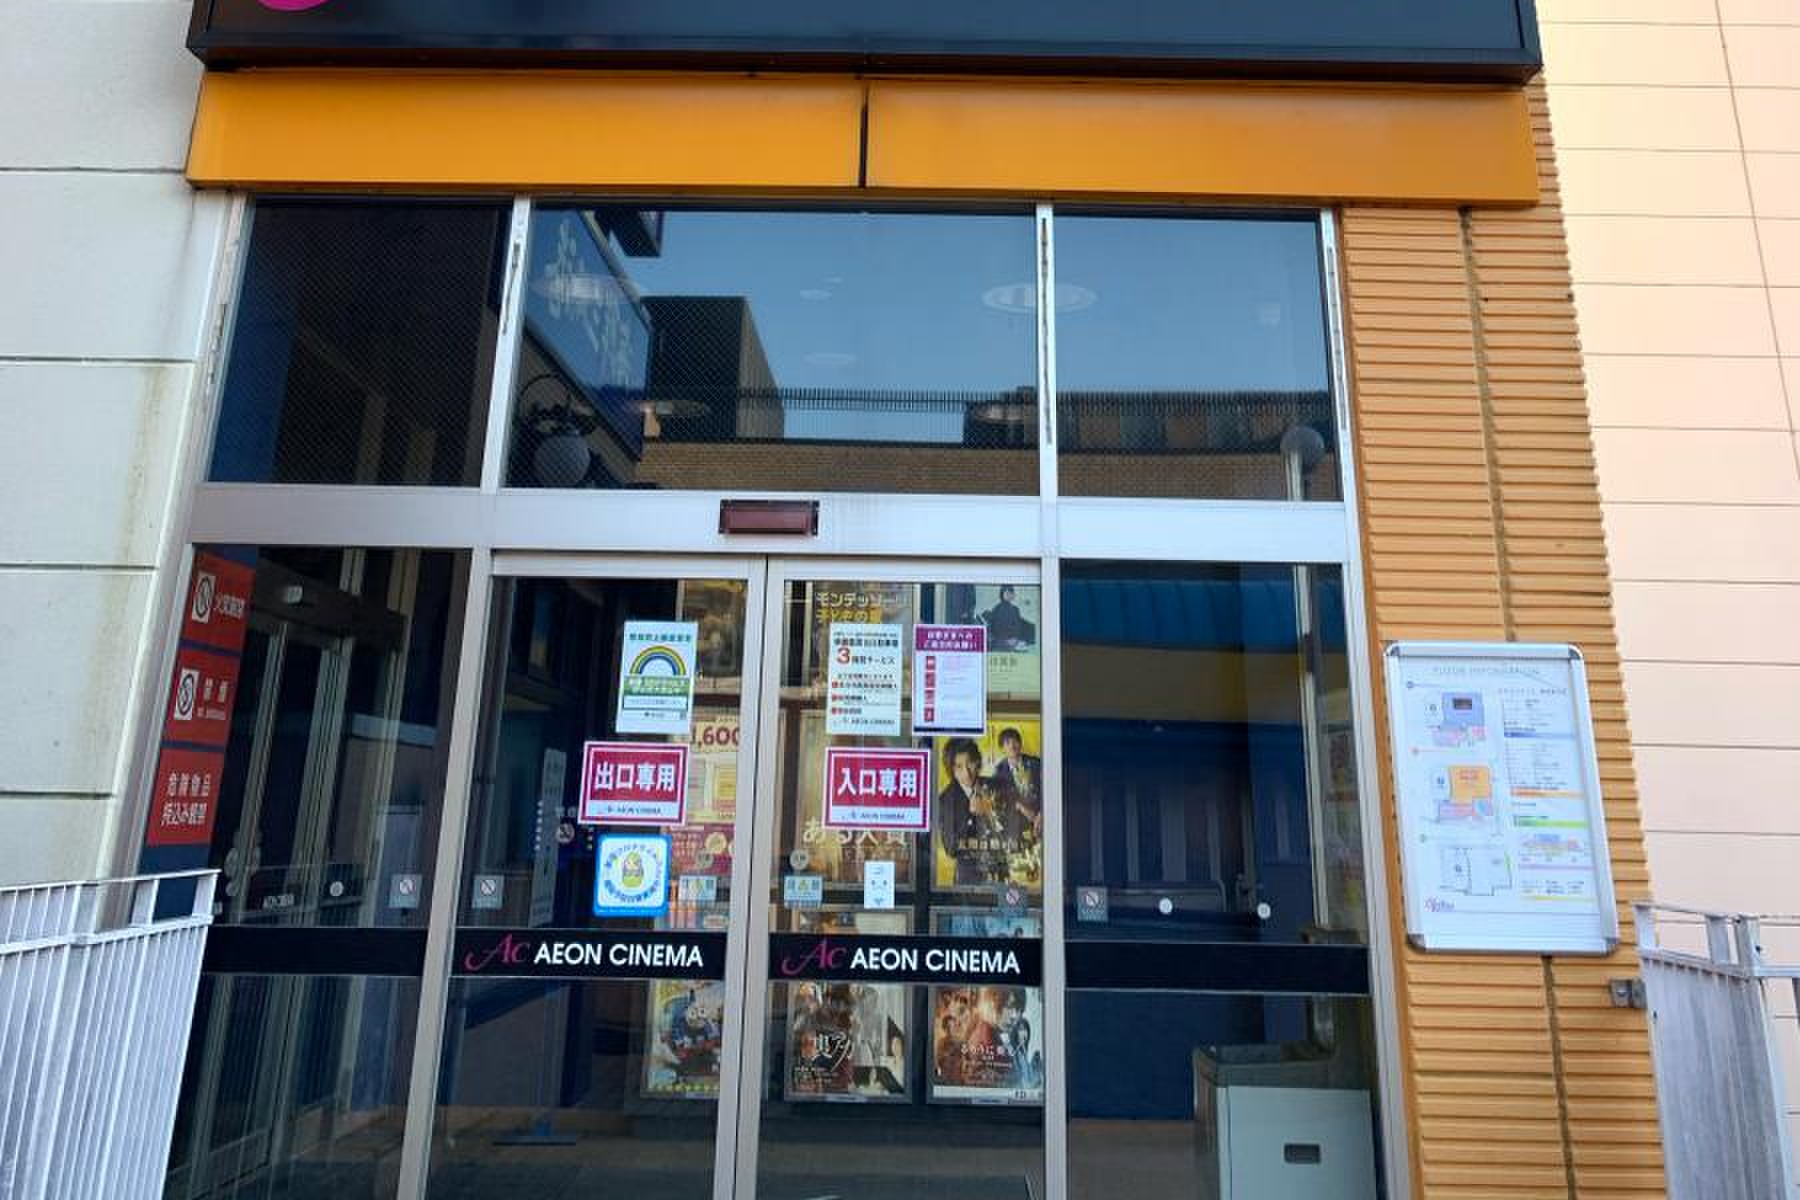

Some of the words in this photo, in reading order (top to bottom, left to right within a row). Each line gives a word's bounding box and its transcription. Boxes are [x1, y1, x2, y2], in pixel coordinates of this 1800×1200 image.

[594, 761, 676, 792] 出口専用
[837, 767, 917, 799] 入口専用
[534, 941, 601, 965] AEON
[609, 942, 704, 968] CINEMA
[850, 947, 917, 971] AEON
[925, 949, 1021, 975] CINEMA
